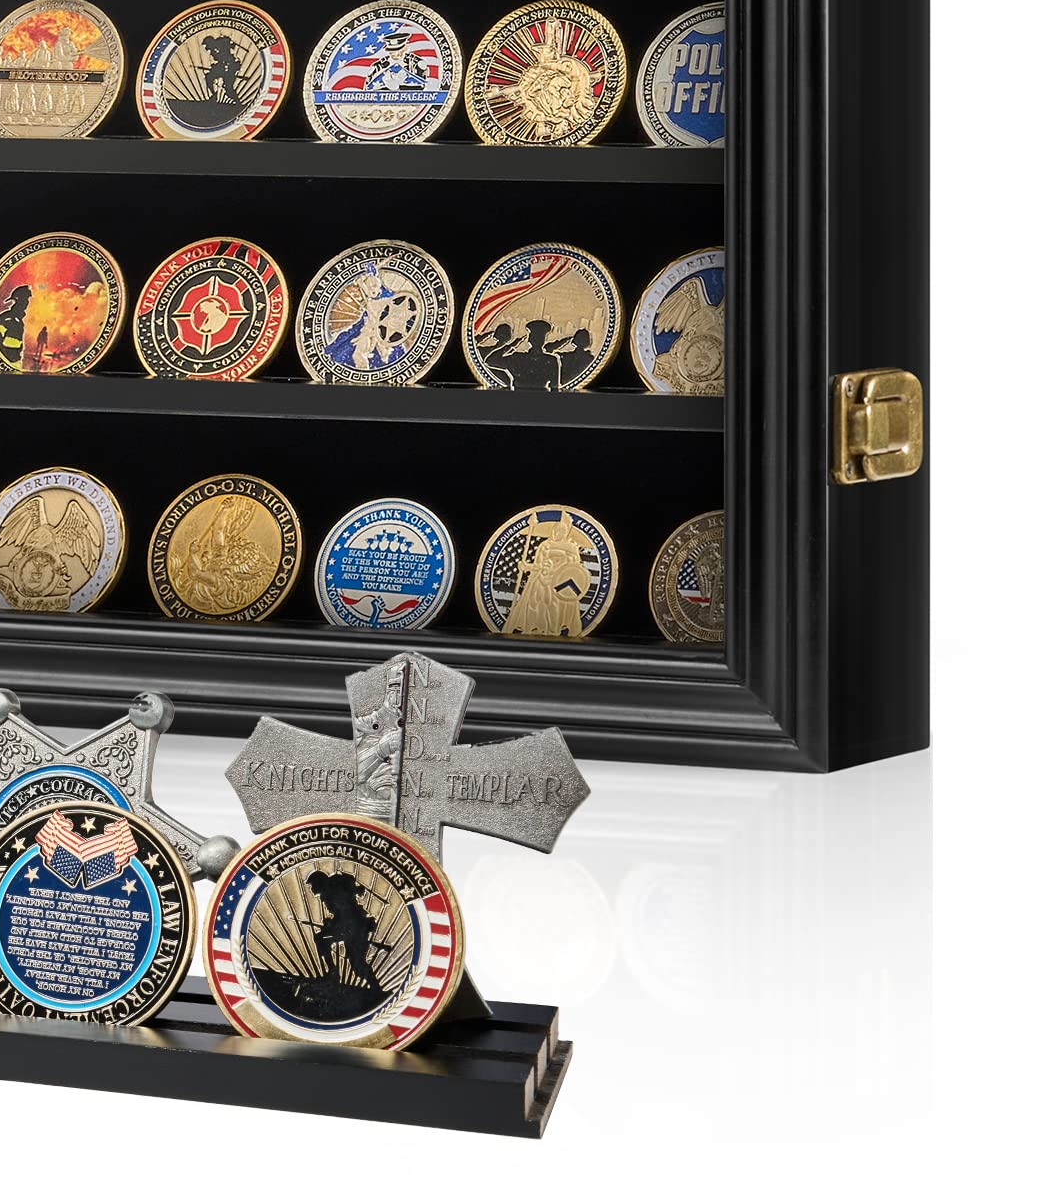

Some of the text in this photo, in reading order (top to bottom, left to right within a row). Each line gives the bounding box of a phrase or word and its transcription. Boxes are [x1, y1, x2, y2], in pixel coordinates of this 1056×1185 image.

[530, 8, 598, 28] SURRENDER
[315, 9, 452, 72] BLESSED ARE THE PEACEMAKERS
[671, 43, 724, 75] POL
[325, 92, 438, 101] REMEMBER THE FALLEN
[317, 106, 340, 139] FAITH
[393, 107, 438, 143] COURAGE
[14, 251, 26, 260] IS
[26, 242, 48, 256] NOT
[50, 239, 71, 248] THE
[71, 239, 108, 274] ABSENCE
[107, 272, 115, 286] OF
[143, 243, 214, 311] THANK YOU
[158, 259, 214, 312] COMMITMENT
[304, 246, 443, 321] WE ARE PRAYING FOR YOU
[655, 254, 717, 299] LIBERTY
[110, 286, 120, 317] FEAR
[155, 333, 184, 368] PRIDE
[212, 319, 265, 369] COURAGE
[422, 306, 448, 365] SERVICE
[2, 474, 115, 547] LIBERTY WE DEFEND
[236, 480, 296, 552] ST. MICHAEL
[363, 509, 427, 528] THANK YOU
[153, 491, 203, 581] PATRON SAINT
[655, 539, 686, 603] RESPECT
[242, 760, 355, 793] KNIGHTS
[446, 774, 568, 807] TEMPLAR
[248, 827, 434, 894] THANK YOU FOR YOUR SERVICE
[280, 845, 405, 887] HONORING ALL VETERANS
[157, 882, 181, 932] LAW
[24, 969, 56, 980] BETRAY
[58, 973, 84, 985] NEVER
[67, 987, 80, 995] MY
[85, 977, 104, 988] WILL
[82, 988, 94, 997] ON
